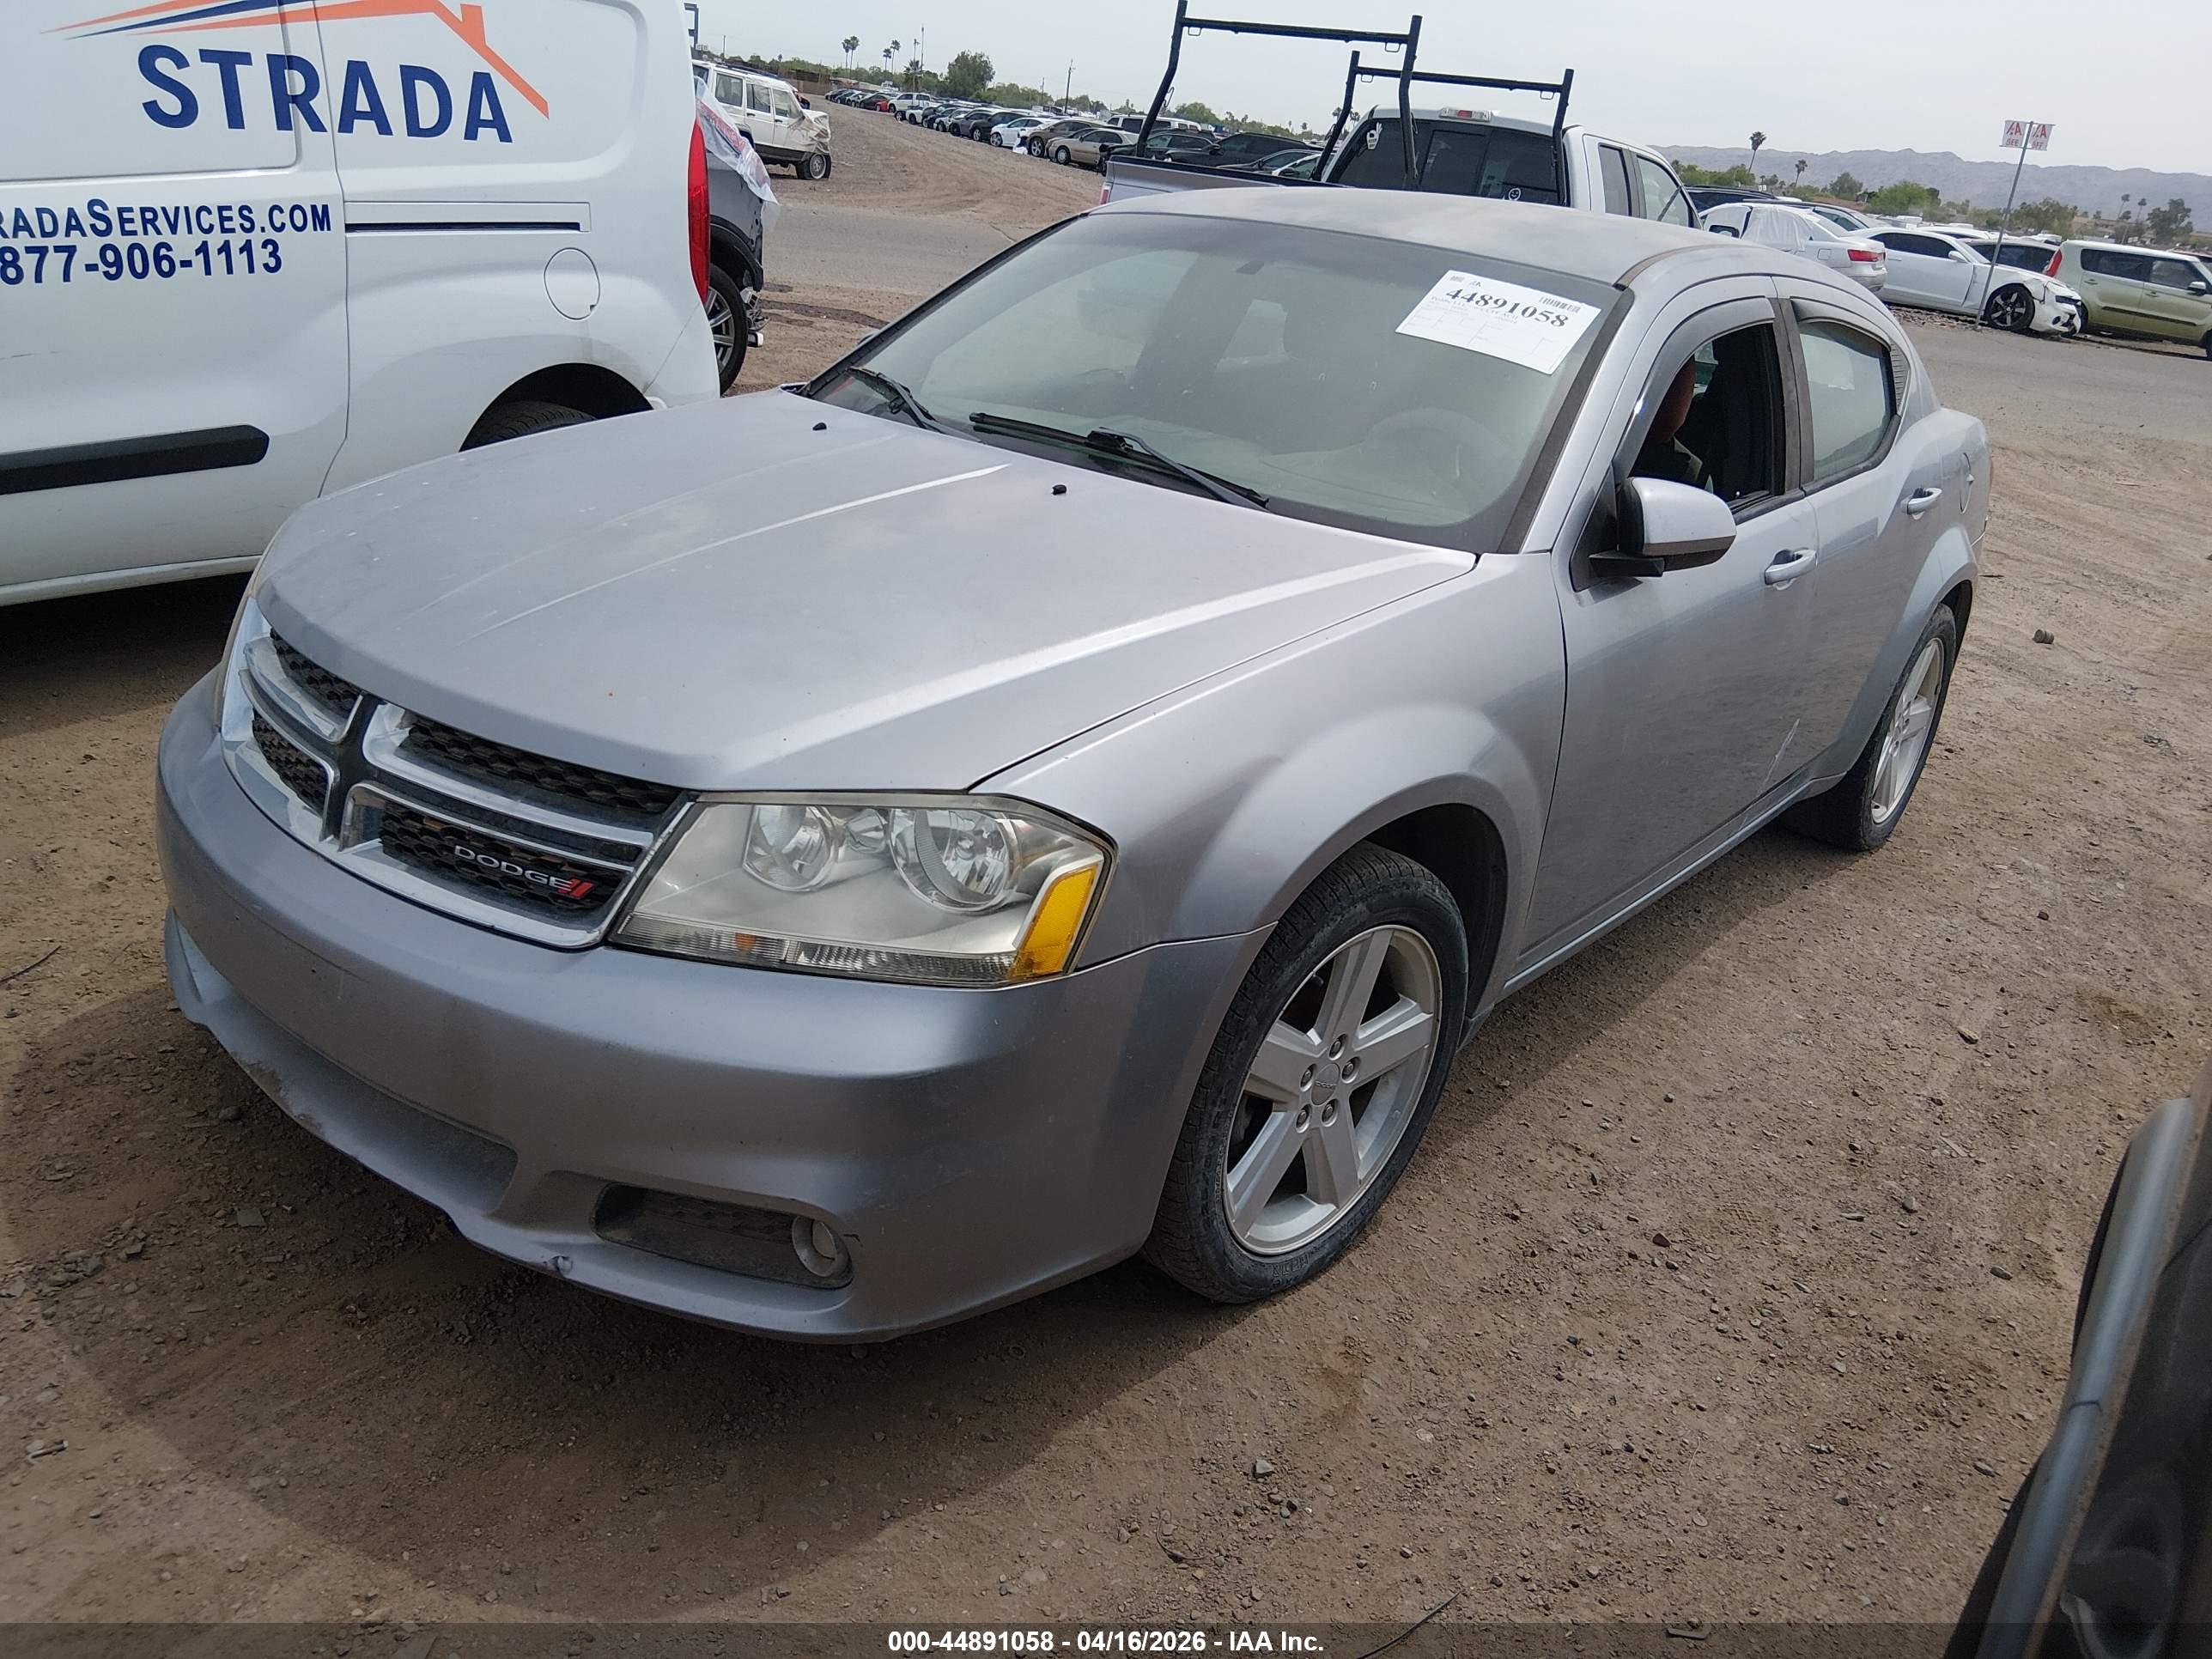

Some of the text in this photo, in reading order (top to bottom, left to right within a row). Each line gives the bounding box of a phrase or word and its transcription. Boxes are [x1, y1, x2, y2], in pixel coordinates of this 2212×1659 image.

[138, 45, 513, 143] STRADA
[1446, 289, 1569, 327] 44891058
[454, 845, 573, 891] DODGE
